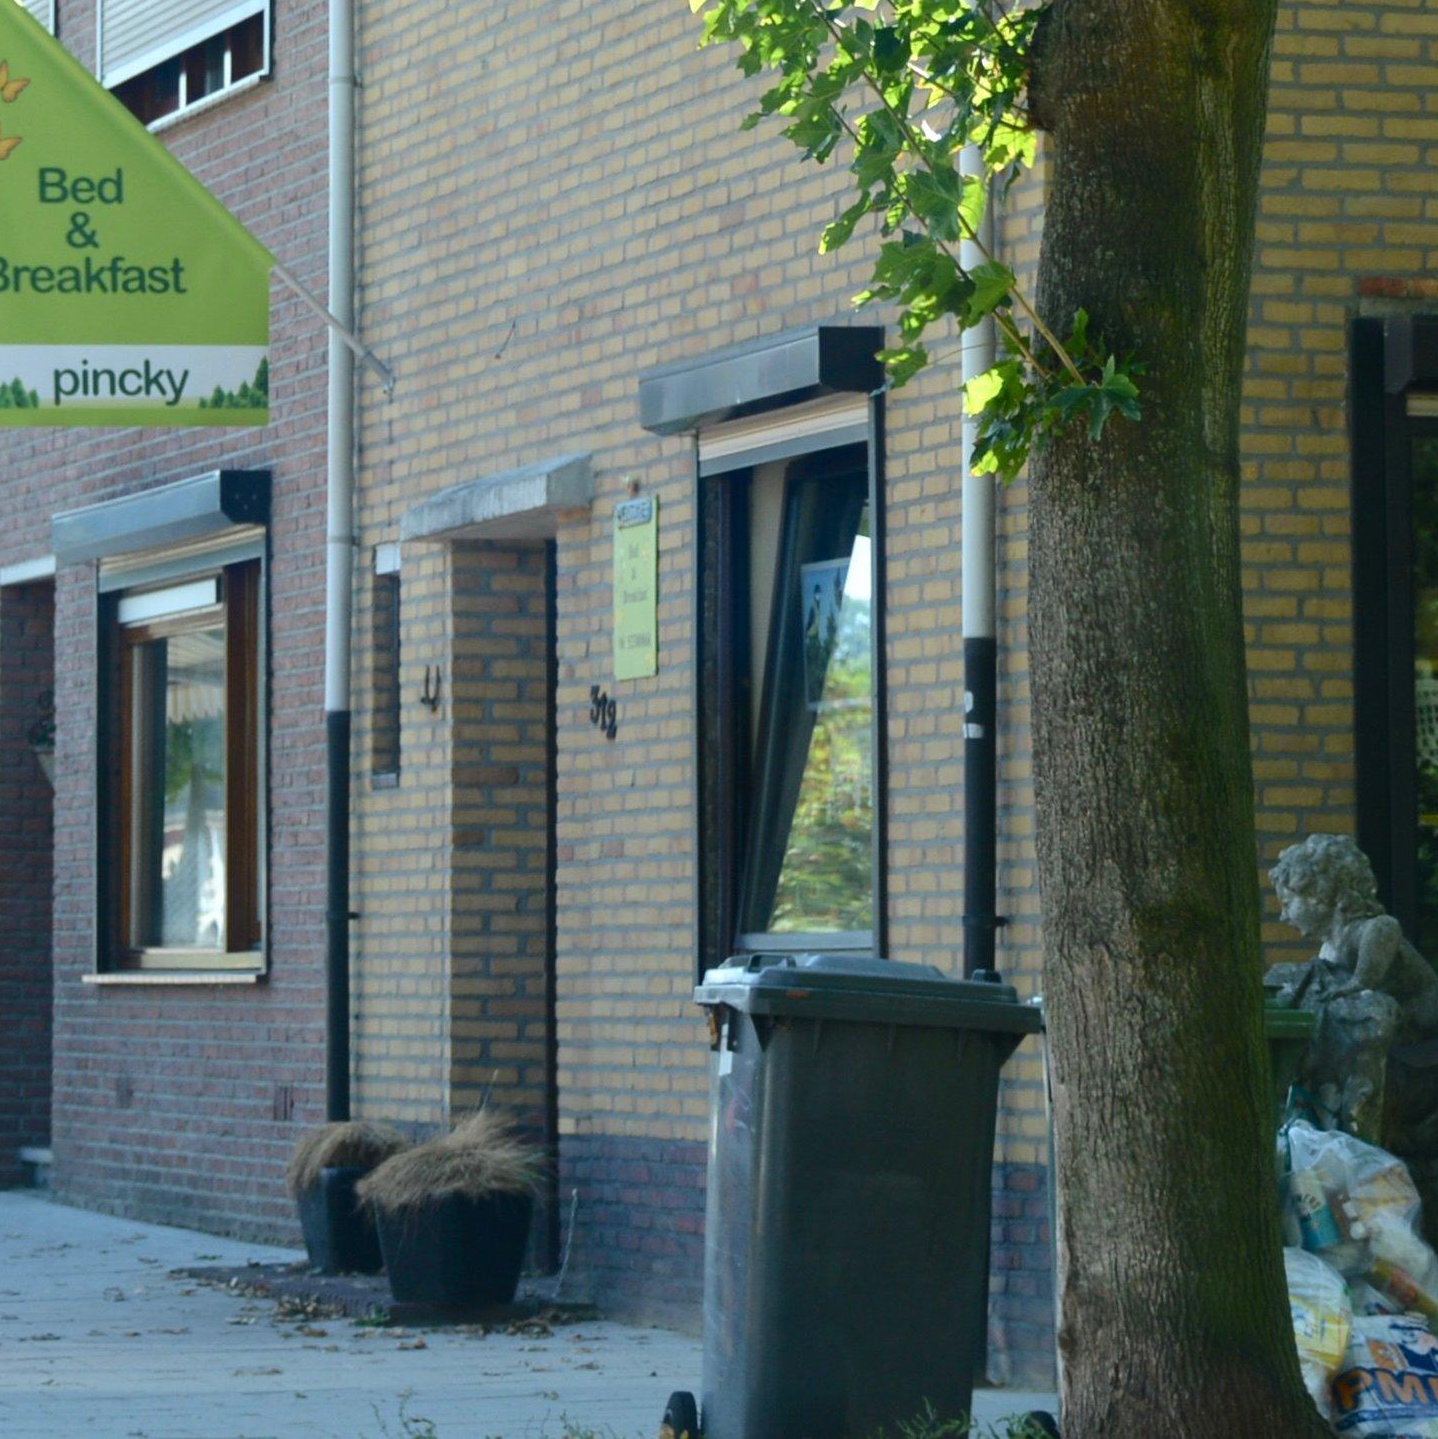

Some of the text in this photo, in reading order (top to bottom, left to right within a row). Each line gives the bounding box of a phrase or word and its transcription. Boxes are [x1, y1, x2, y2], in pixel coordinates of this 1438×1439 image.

[38, 166, 125, 205] Bed
[65, 210, 100, 249] &
[53, 358, 190, 407] pincky
